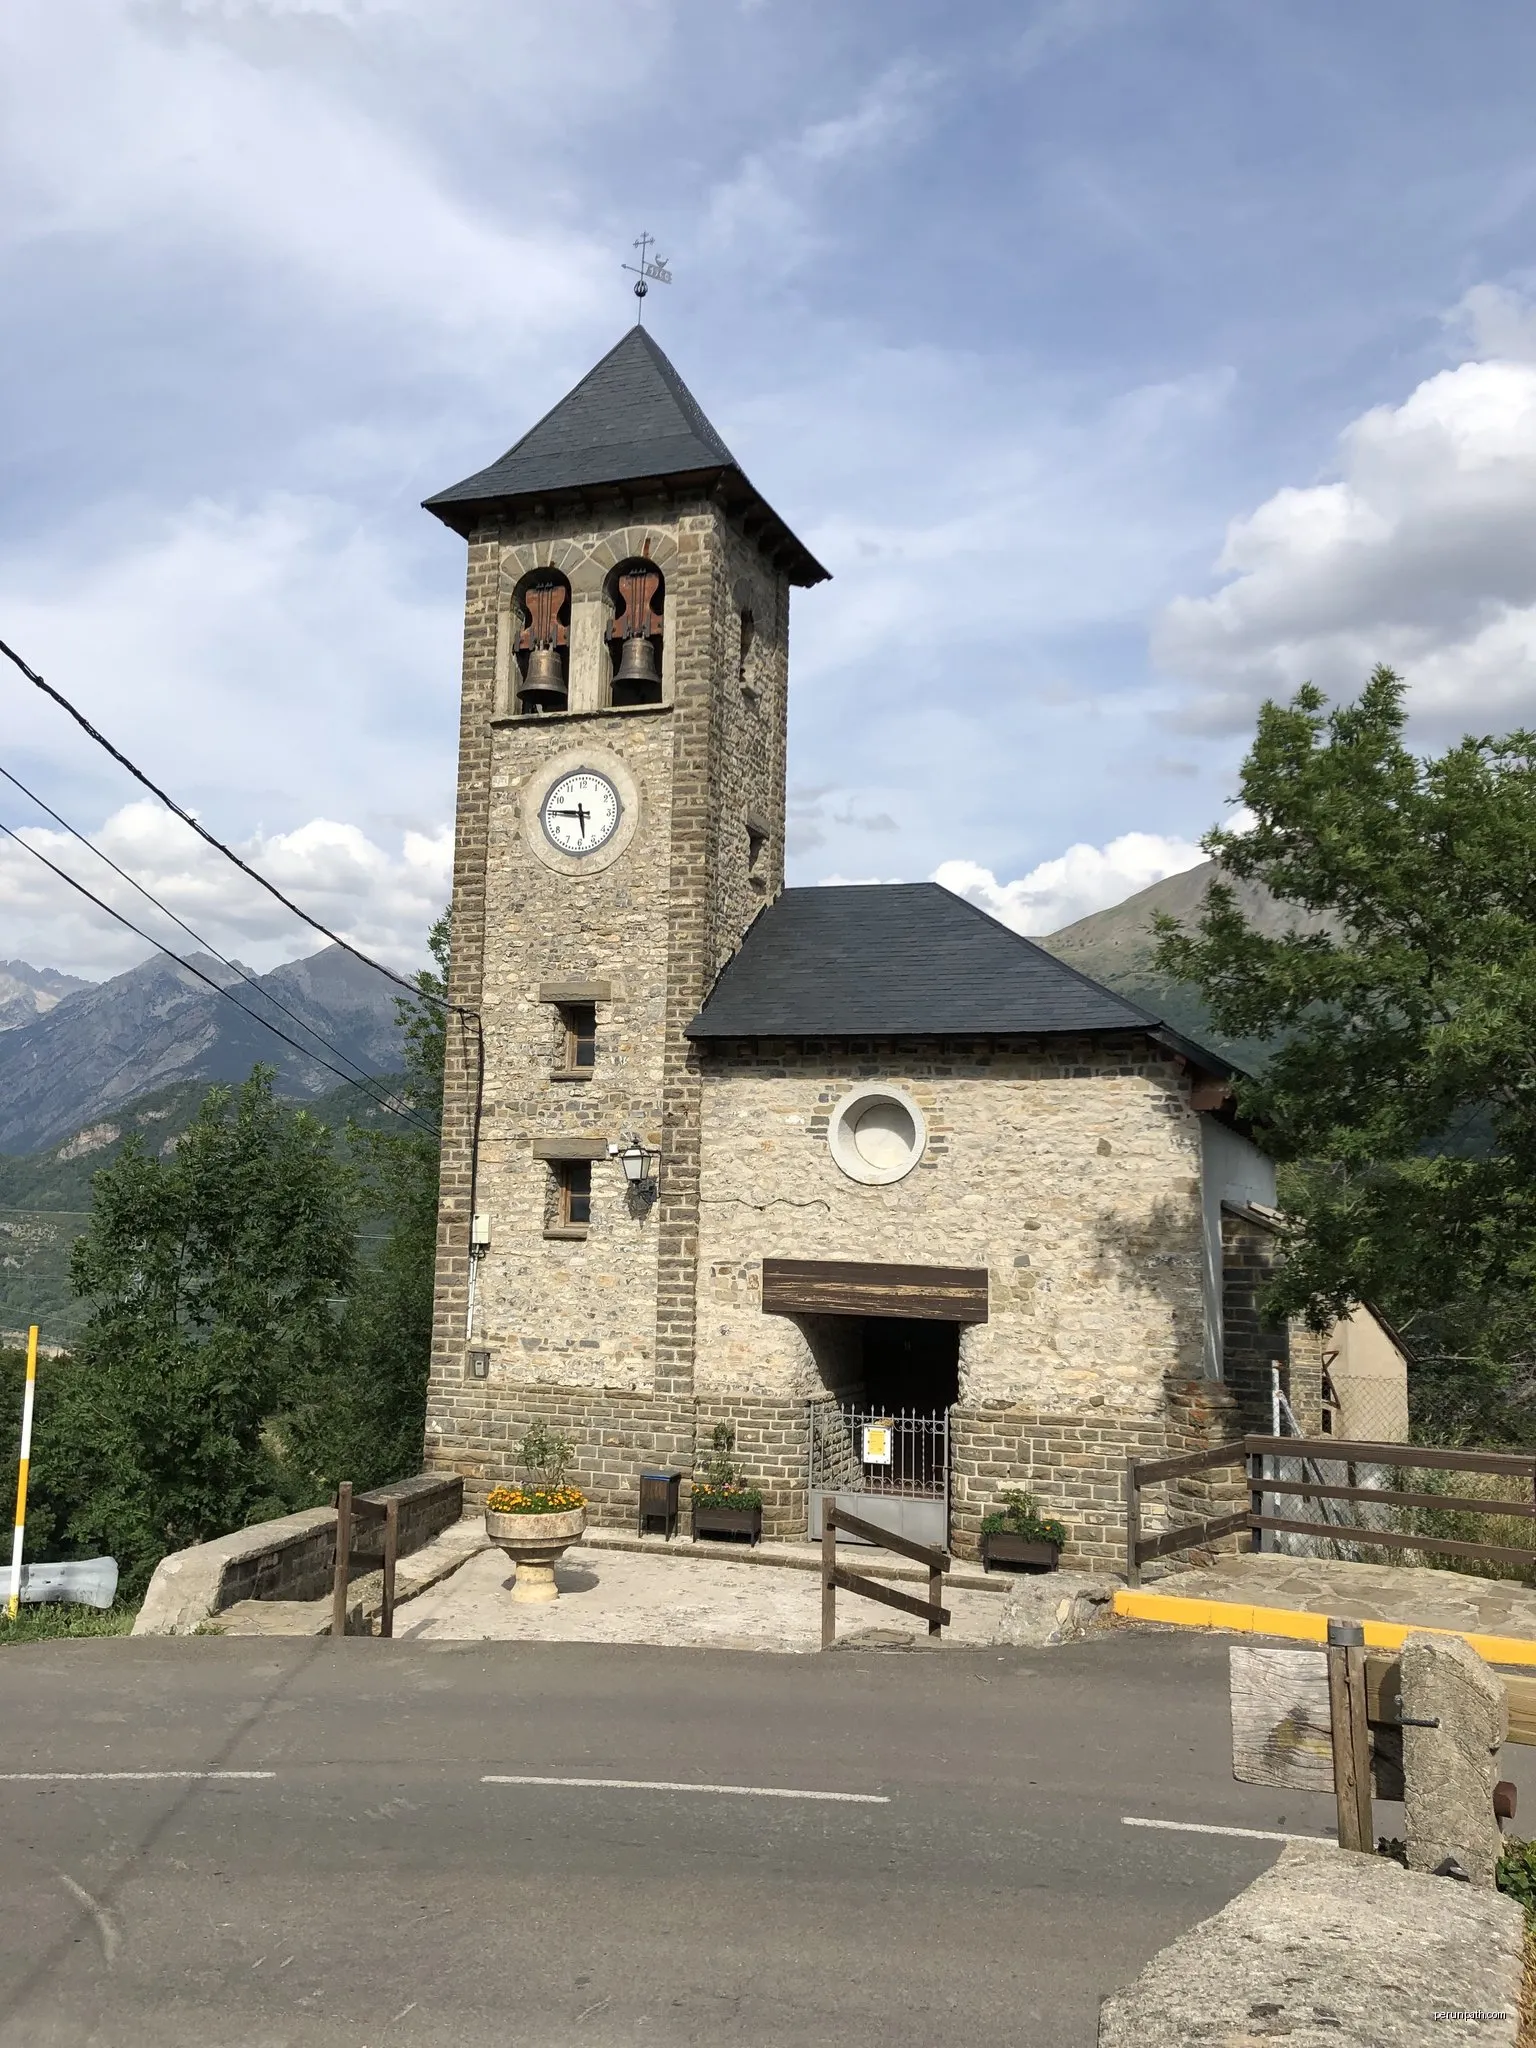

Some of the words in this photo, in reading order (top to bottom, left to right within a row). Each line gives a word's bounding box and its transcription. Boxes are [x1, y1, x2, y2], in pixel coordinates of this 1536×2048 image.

[579, 780, 588, 789] 12
[556, 796, 564, 804] 10
[603, 795, 609, 803] 2
[606, 808, 612, 817] 3
[555, 826, 561, 834] 8
[600, 824, 606, 833] 4
[565, 835, 571, 844] 7
[577, 838, 583, 847] 6
[590, 834, 596, 843] 5
